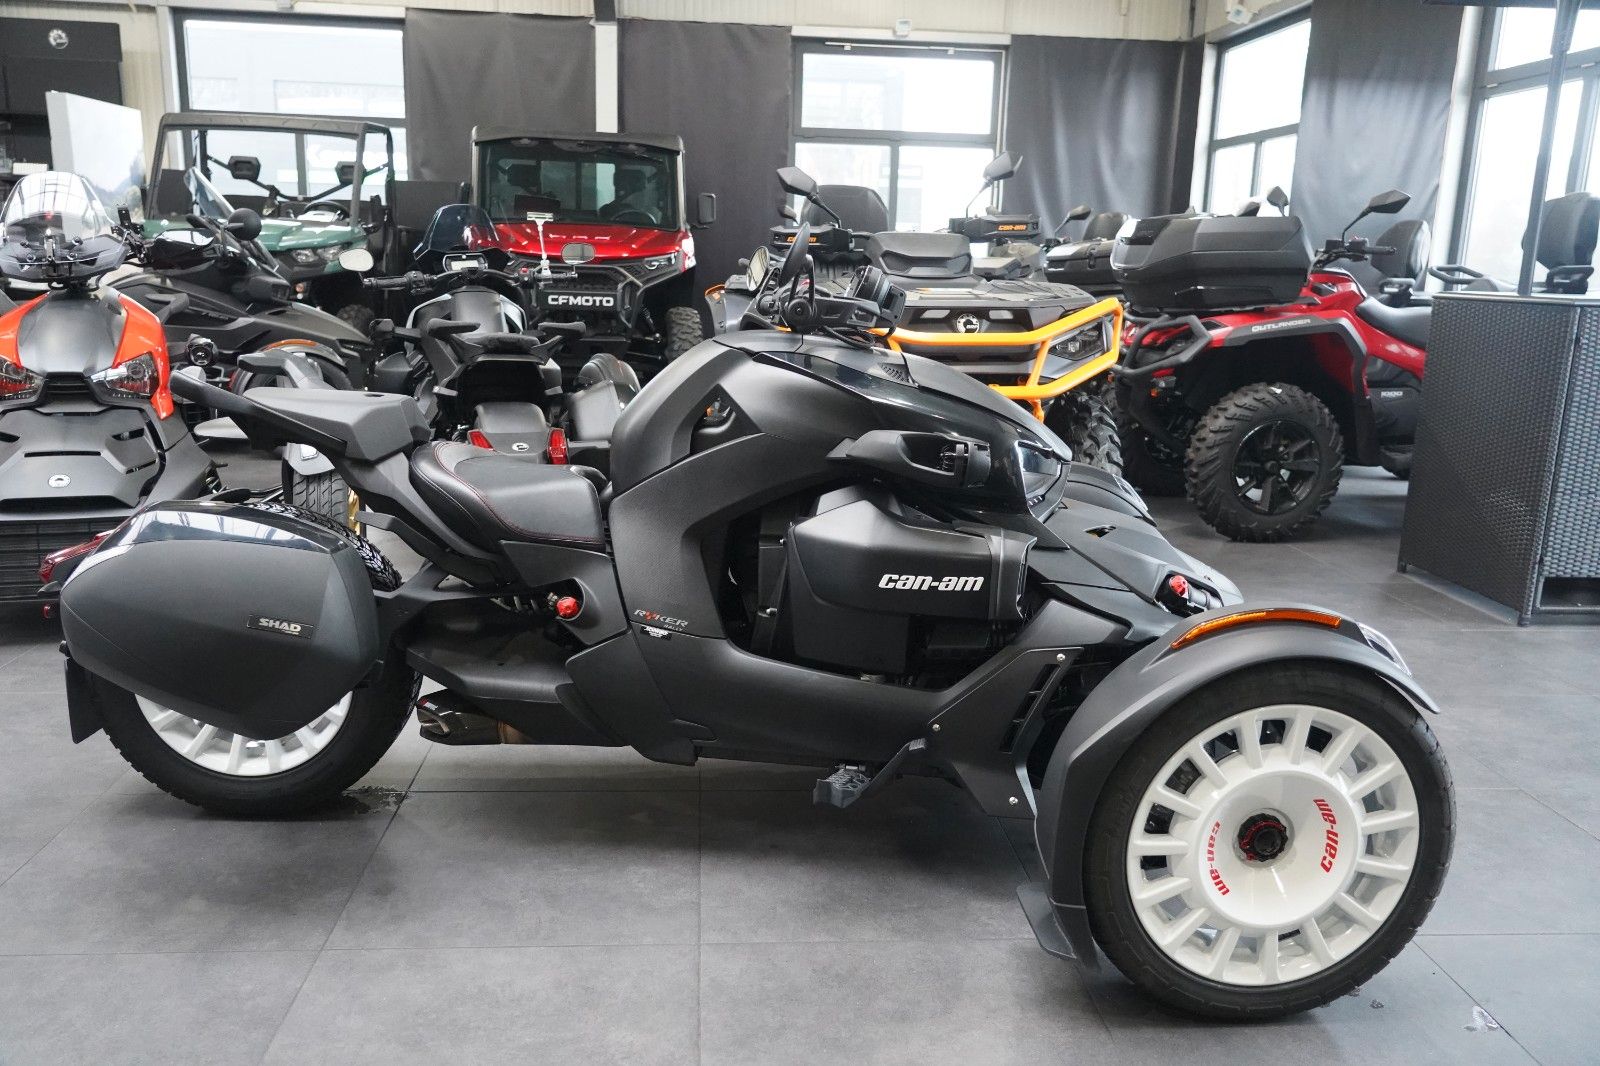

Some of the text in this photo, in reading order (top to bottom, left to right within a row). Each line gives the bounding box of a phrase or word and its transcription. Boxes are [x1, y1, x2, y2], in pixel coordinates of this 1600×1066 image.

[547, 295, 614, 307] CFMOTO
[1251, 318, 1311, 332] OUTLANDER
[878, 573, 985, 592] can-am
[258, 617, 302, 632] SHAD
[633, 609, 689, 627] RYKER
[1312, 798, 1340, 873] can-am
[1206, 820, 1231, 896] can-am
